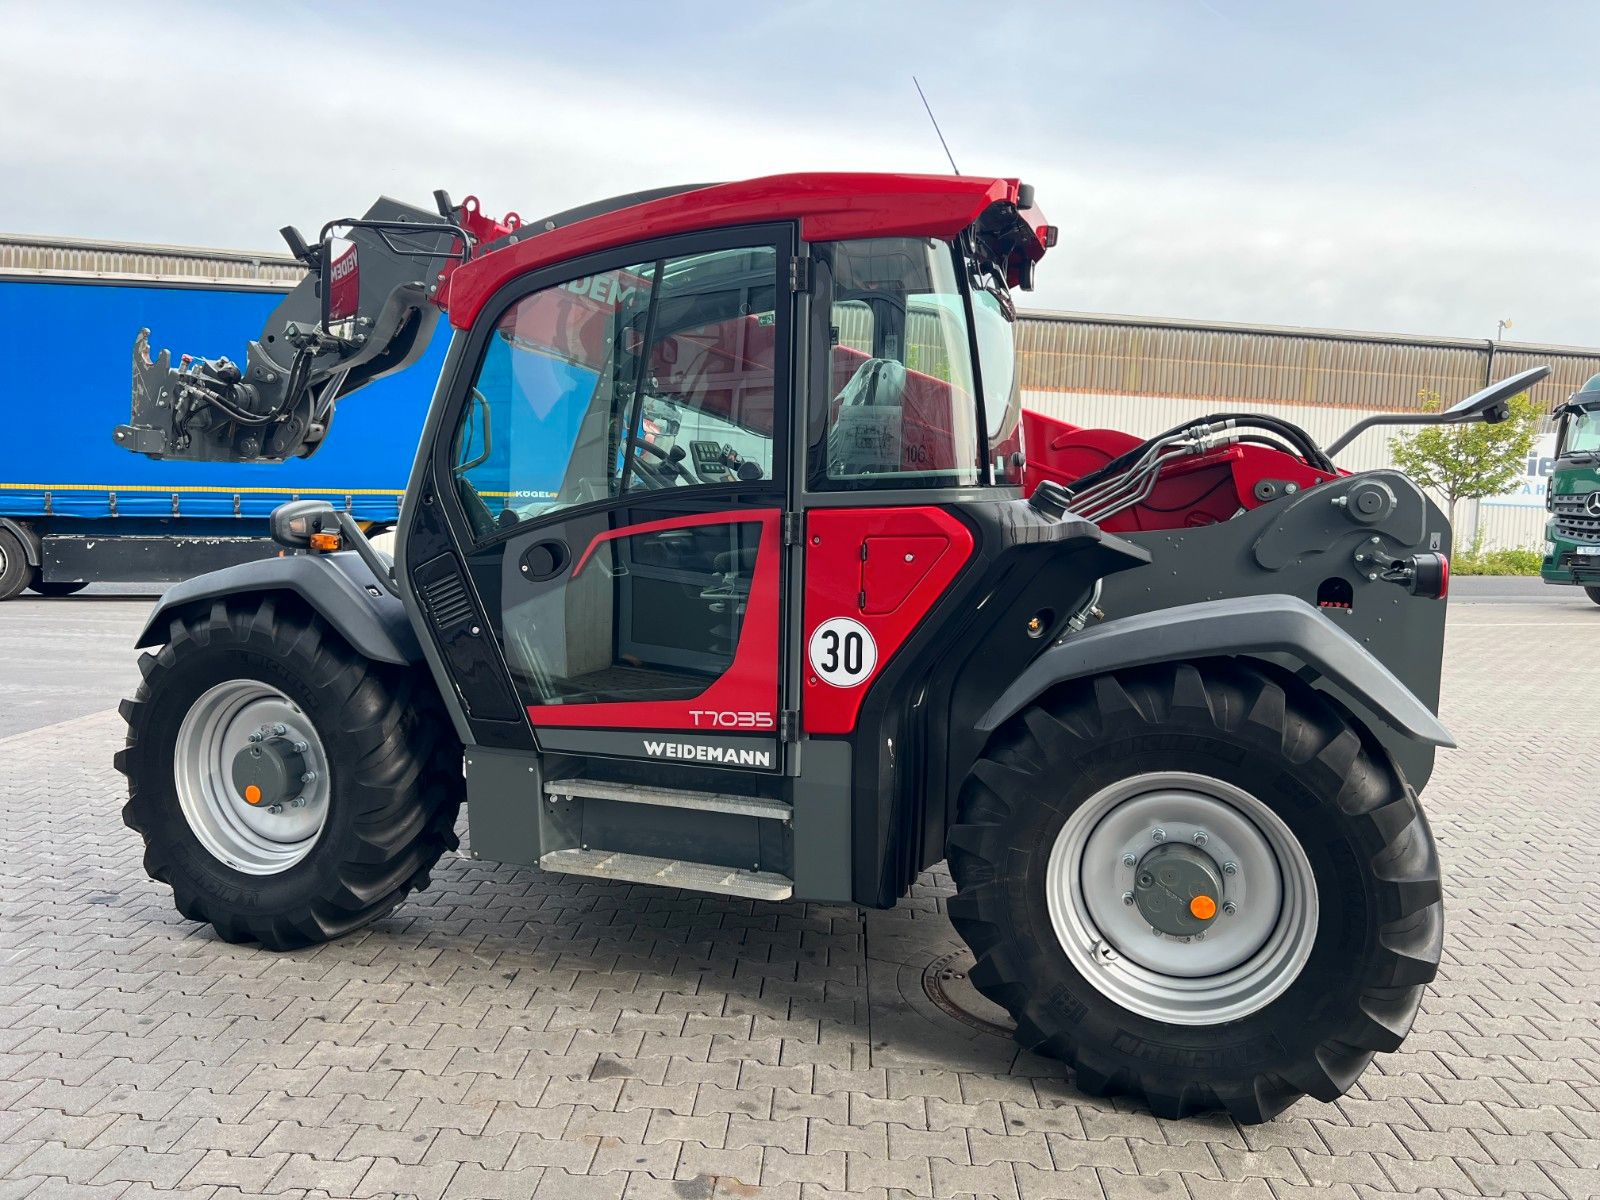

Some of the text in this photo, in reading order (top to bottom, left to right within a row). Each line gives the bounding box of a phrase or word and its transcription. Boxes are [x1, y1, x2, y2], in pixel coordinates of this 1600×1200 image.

[515, 490, 551, 498] KÖGEL
[821, 629, 863, 675] 30
[688, 710, 774, 727] T7035
[643, 740, 770, 767] WEIDEMANN
